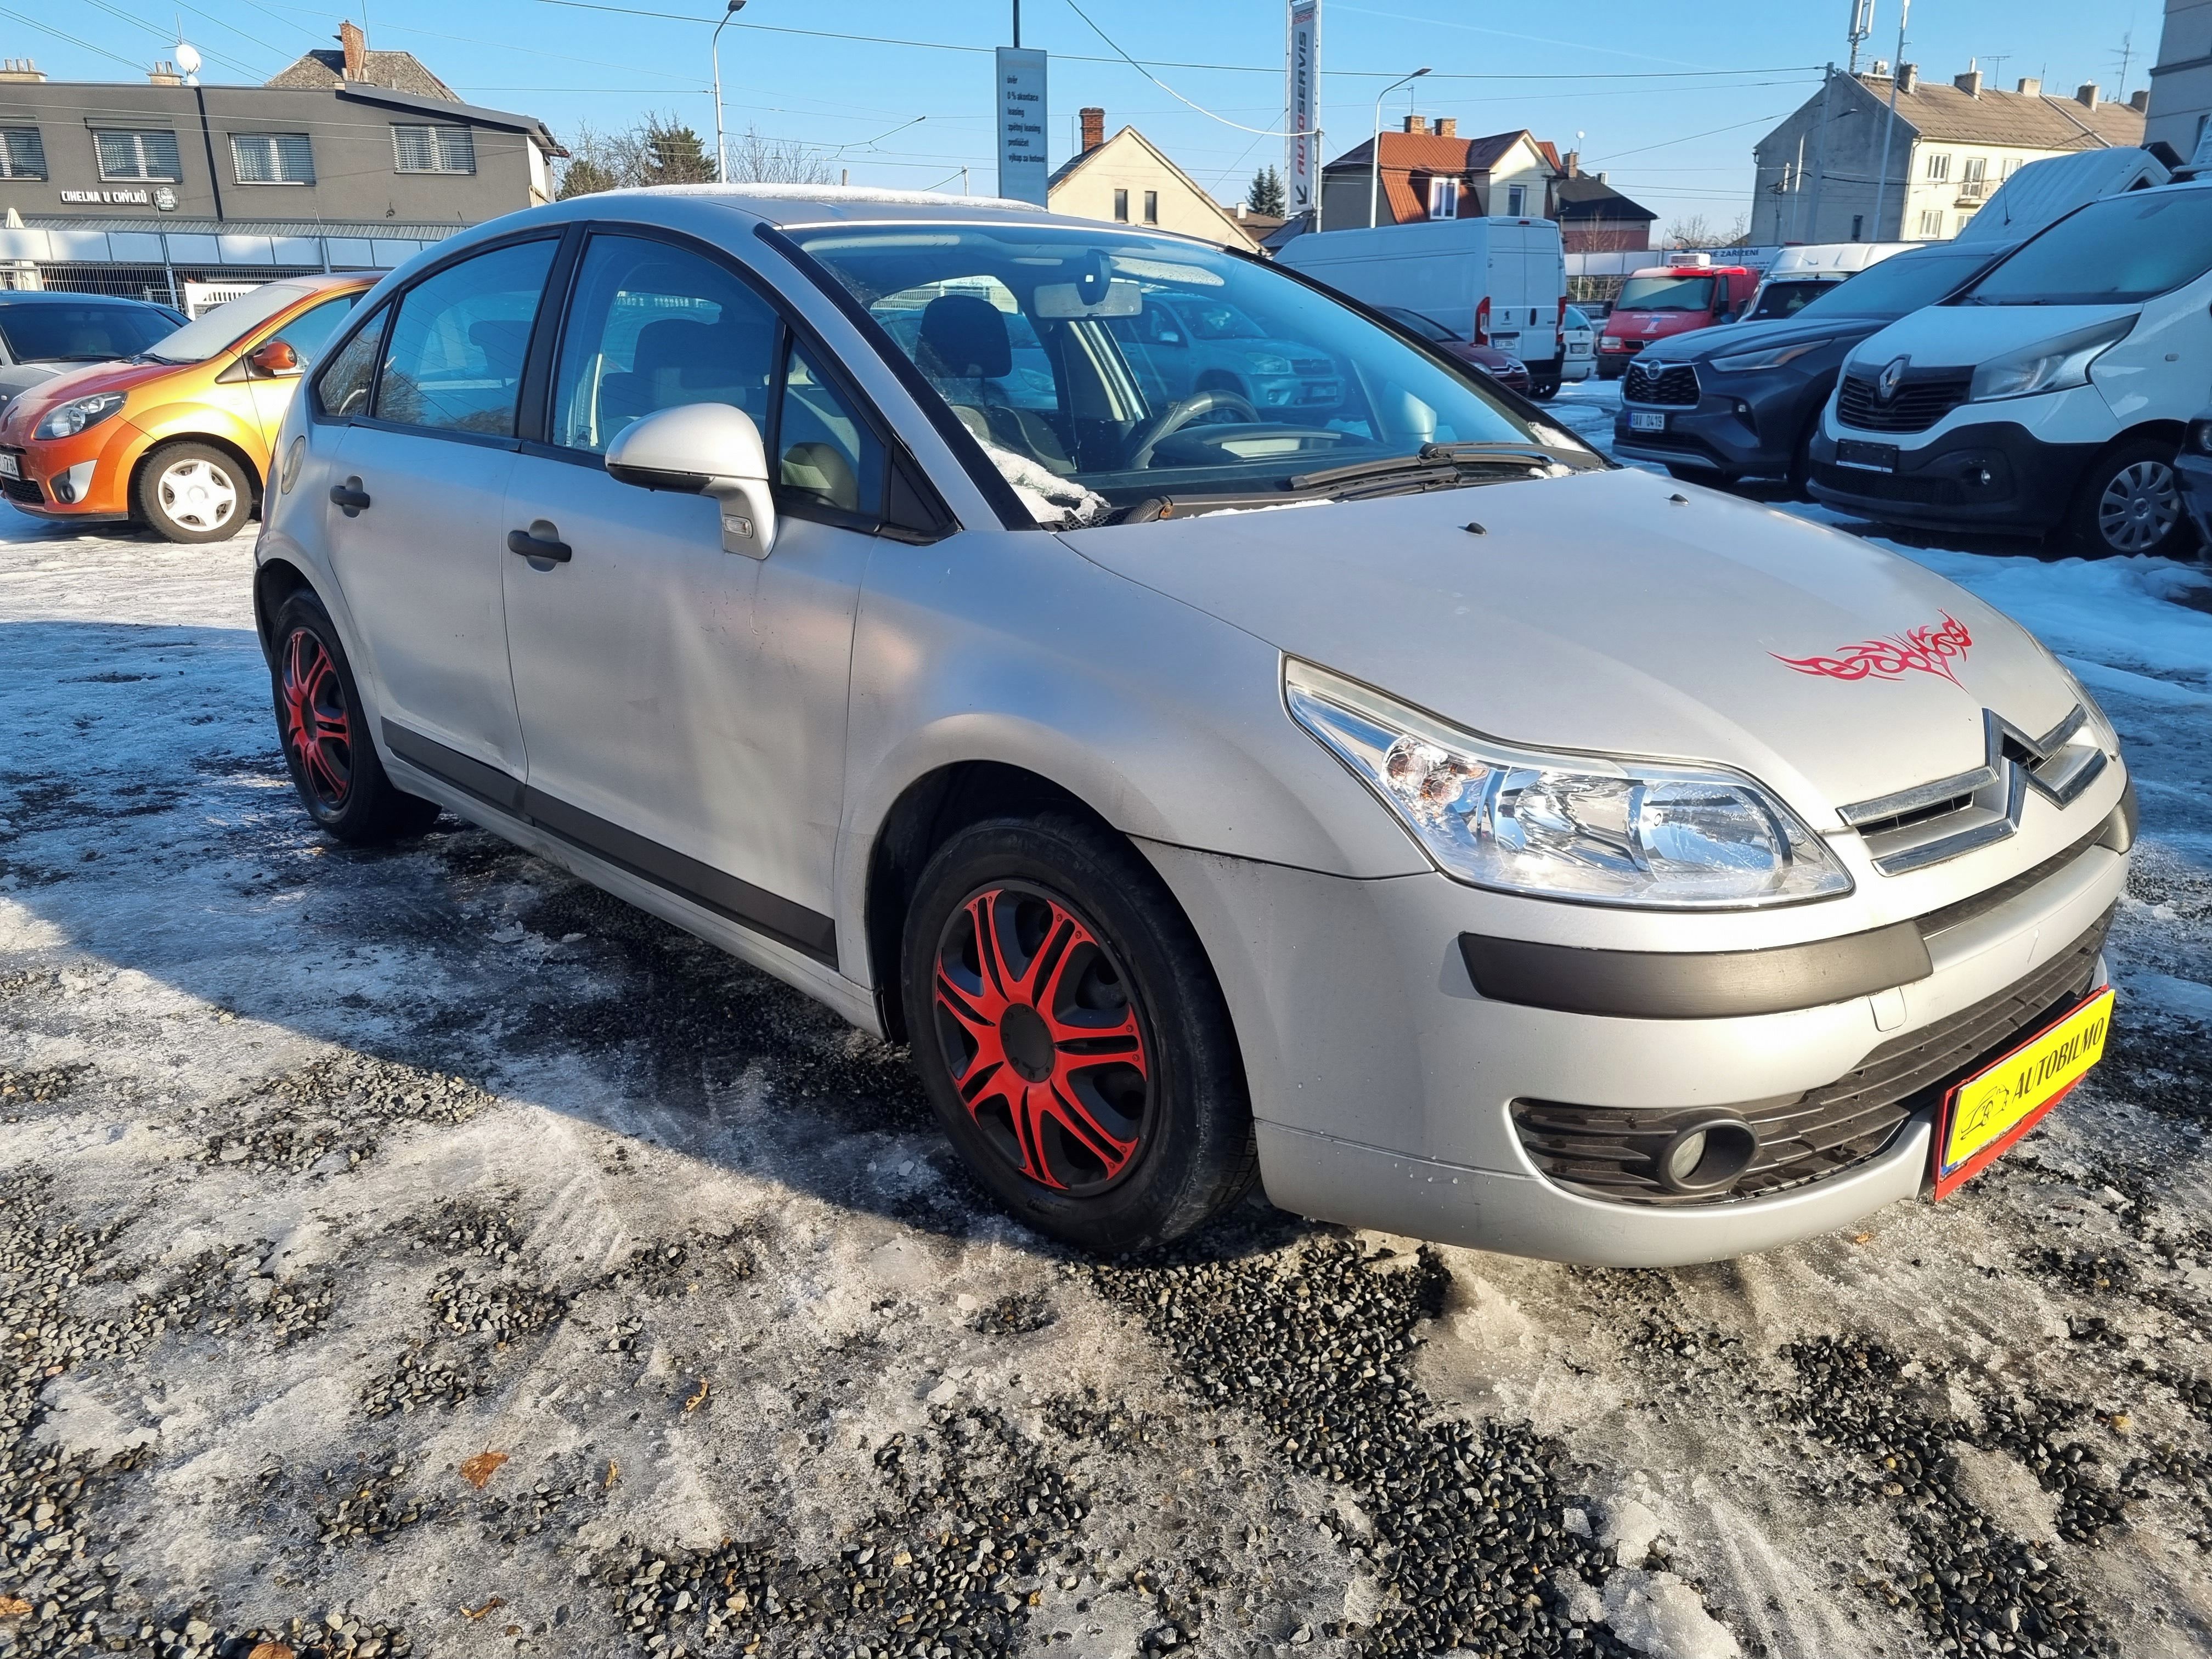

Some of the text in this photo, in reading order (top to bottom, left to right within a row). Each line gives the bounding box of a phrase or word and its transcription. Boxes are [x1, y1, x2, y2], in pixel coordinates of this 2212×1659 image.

[1296, 31, 1307, 176] AUTOSERVIS
[61, 190, 101, 202] CIHELNA
[103, 192, 110, 202] U
[2011, 1017, 2105, 1104] AUTOBILMO
